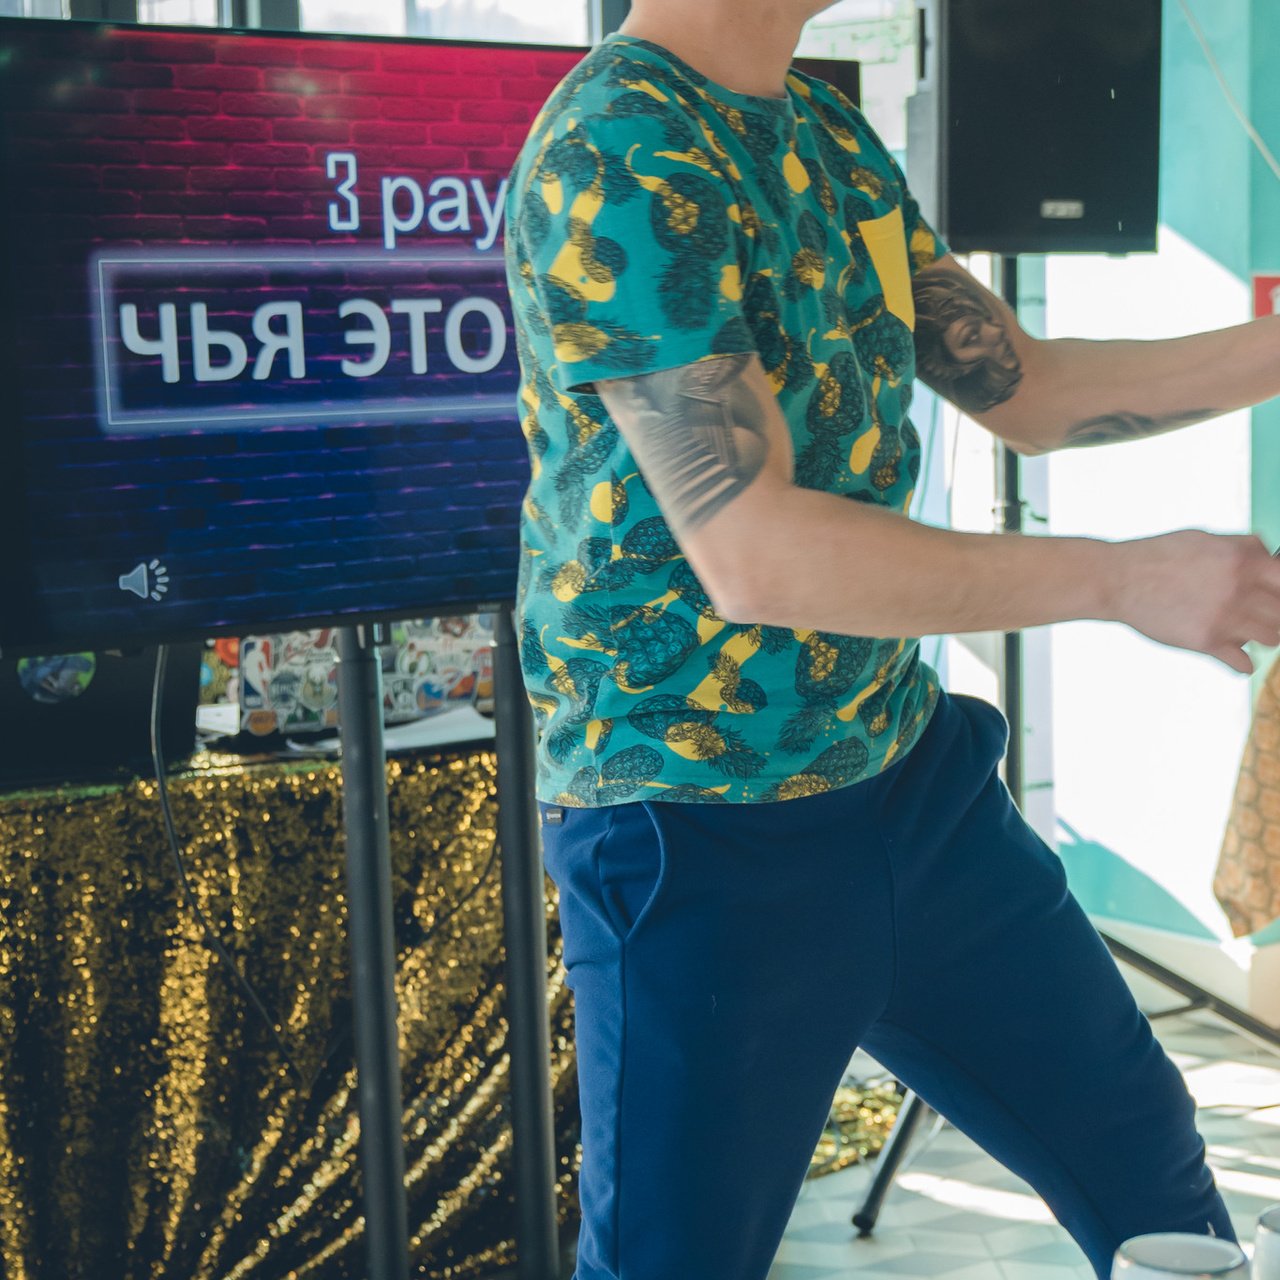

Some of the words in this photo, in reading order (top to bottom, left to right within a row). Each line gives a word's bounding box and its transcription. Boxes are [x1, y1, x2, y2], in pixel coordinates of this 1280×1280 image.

[326, 152, 360, 231] 3
[381, 176, 508, 251] рау
[119, 301, 306, 384] ЧЬЯ
[339, 296, 507, 379] ЭТО
